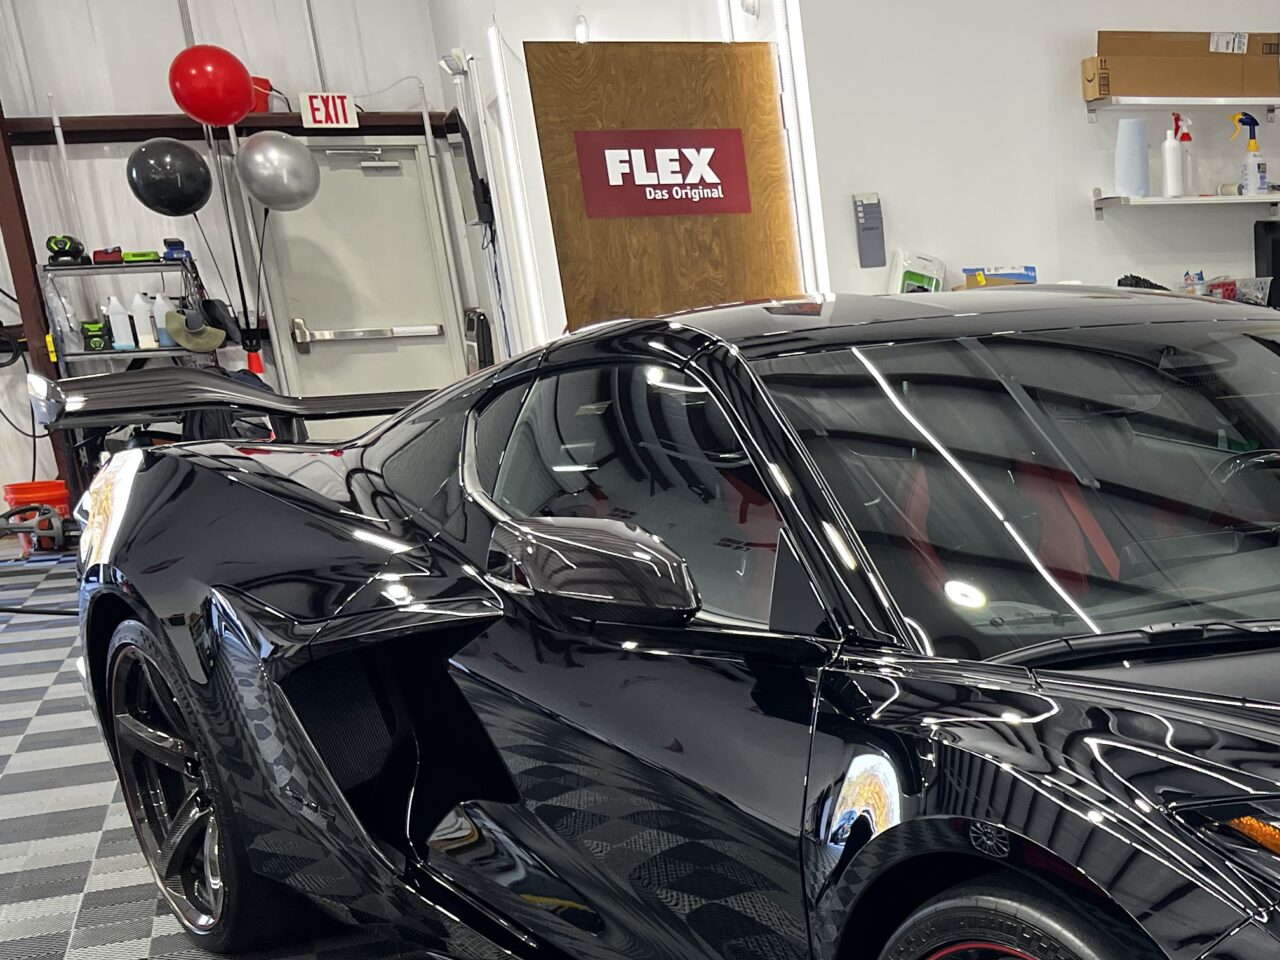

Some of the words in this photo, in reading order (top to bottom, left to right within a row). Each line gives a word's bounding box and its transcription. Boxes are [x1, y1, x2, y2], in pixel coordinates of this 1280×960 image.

[308, 95, 348, 124] EXIT
[604, 148, 721, 185] FLEX
[645, 187, 669, 200] Das
[672, 186, 724, 201] Original
